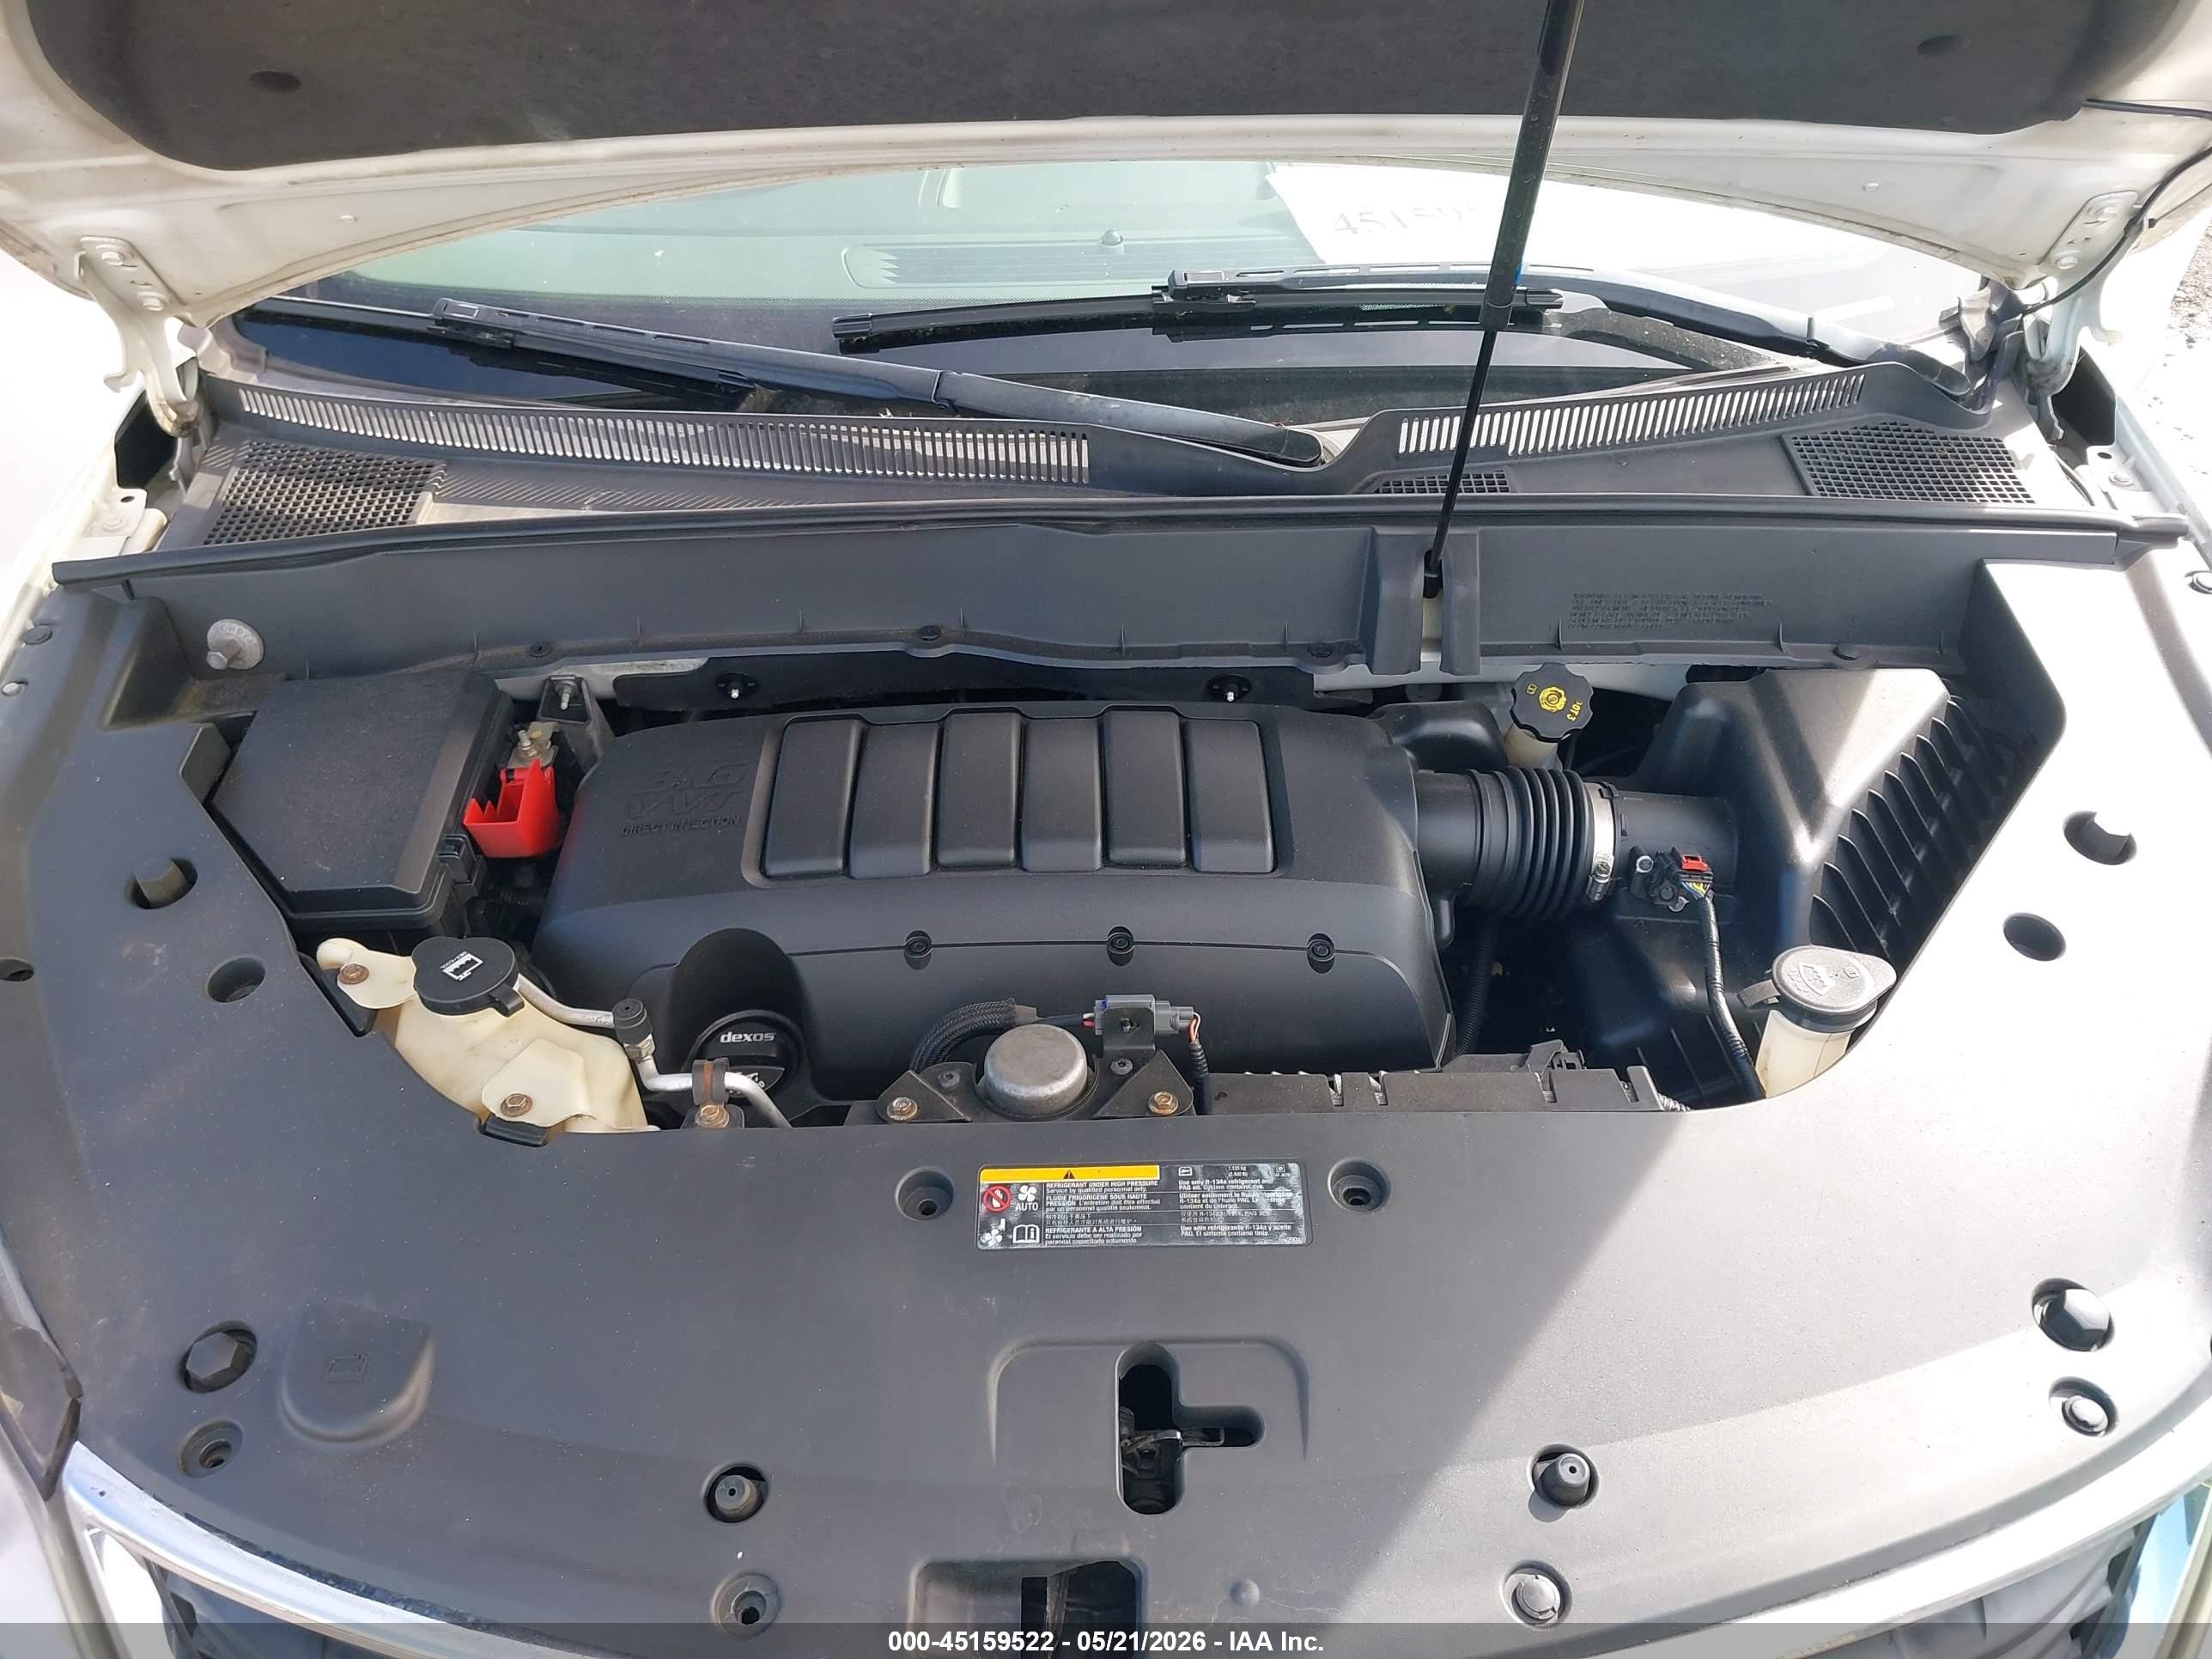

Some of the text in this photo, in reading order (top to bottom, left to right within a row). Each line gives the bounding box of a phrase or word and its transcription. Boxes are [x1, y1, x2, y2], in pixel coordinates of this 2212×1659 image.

[622, 815, 741, 837] DIRECT INJECTION
[720, 1031, 777, 1043] dexos
[1015, 1202, 1039, 1212] AUTO
